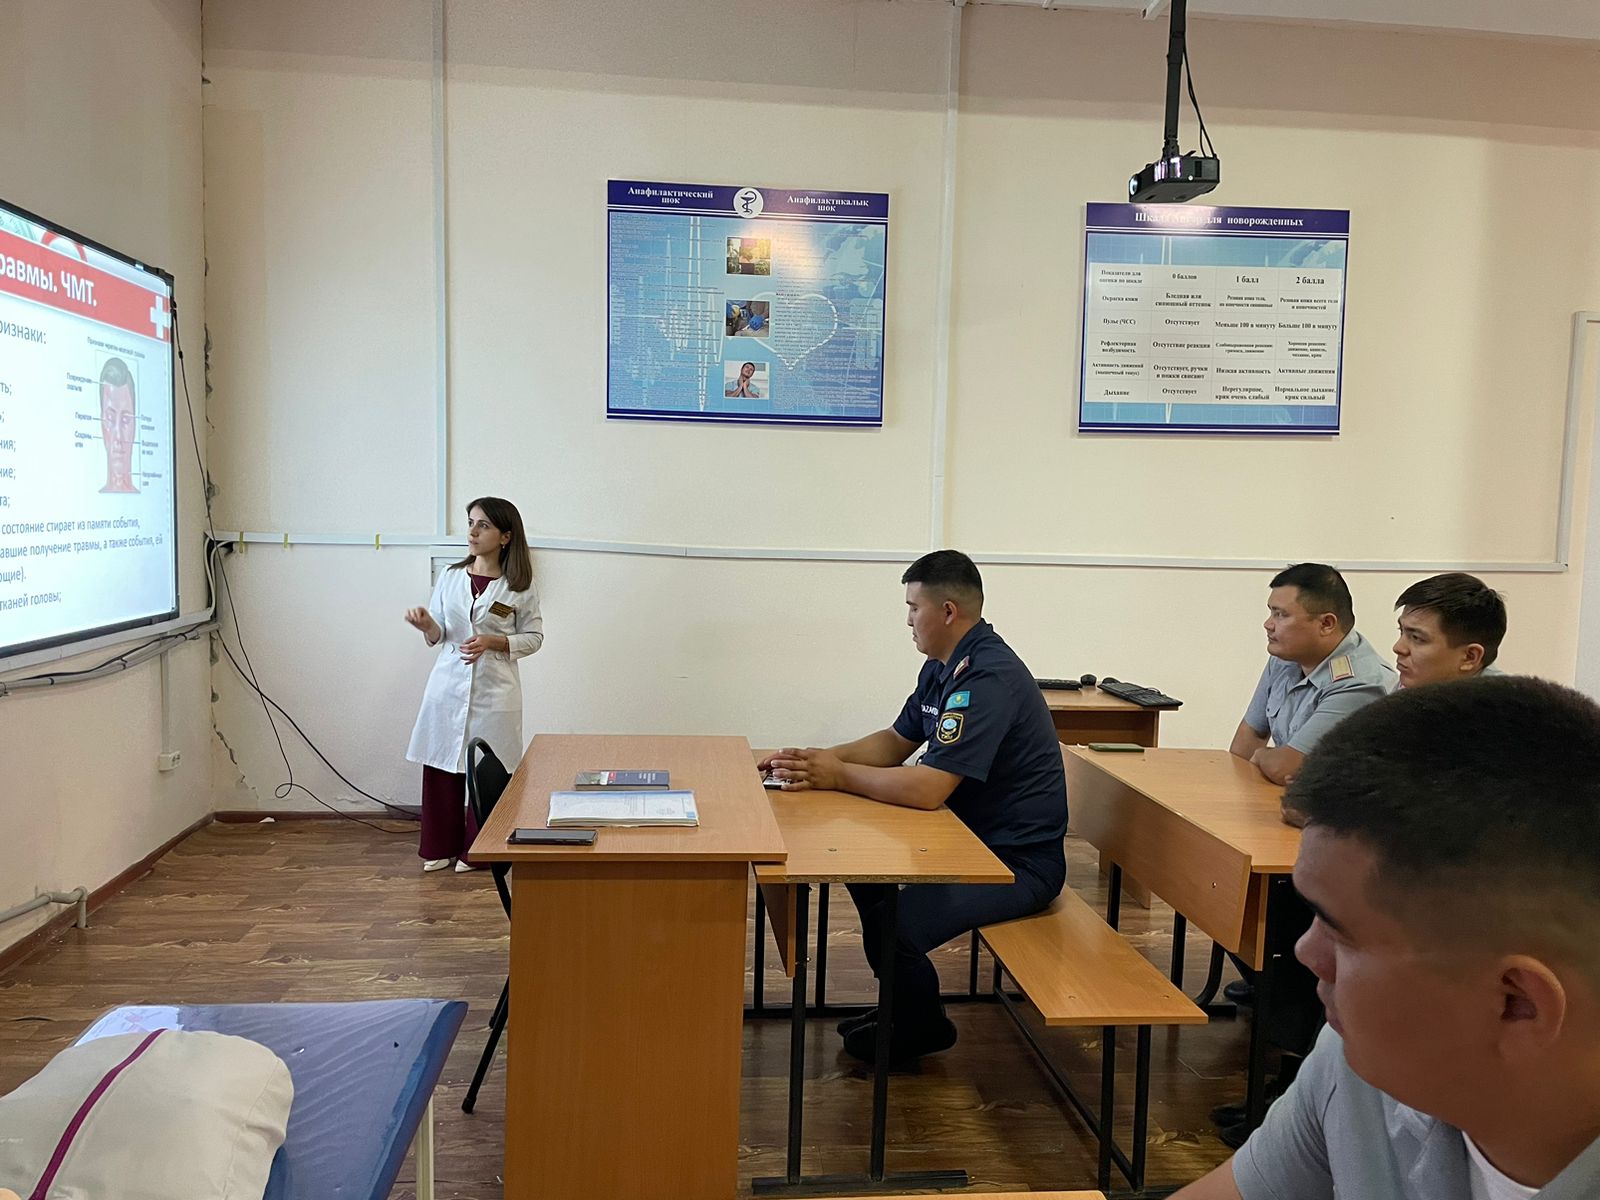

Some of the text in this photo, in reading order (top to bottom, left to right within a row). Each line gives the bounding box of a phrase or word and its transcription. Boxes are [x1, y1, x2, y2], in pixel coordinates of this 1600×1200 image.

[628, 186, 714, 199] Анафилактический
[661, 196, 681, 204] шок
[817, 203, 836, 212] шок
[1135, 212, 1168, 222] Шка
[1227, 216, 1304, 227] новорожденных
[1241, 275, 1259, 283] балл
[1302, 276, 1325, 284] балла
[61, 271, 97, 306] ЧМТ.
[1165, 318, 1200, 326] Отсутствует
[1152, 341, 1186, 349] Отсутствие
[2, 516, 140, 535] состояние стирает из памяти события,
[30, 540, 72, 557] получение
[74, 540, 102, 555] травмы,
[30, 592, 62, 606] головы;
